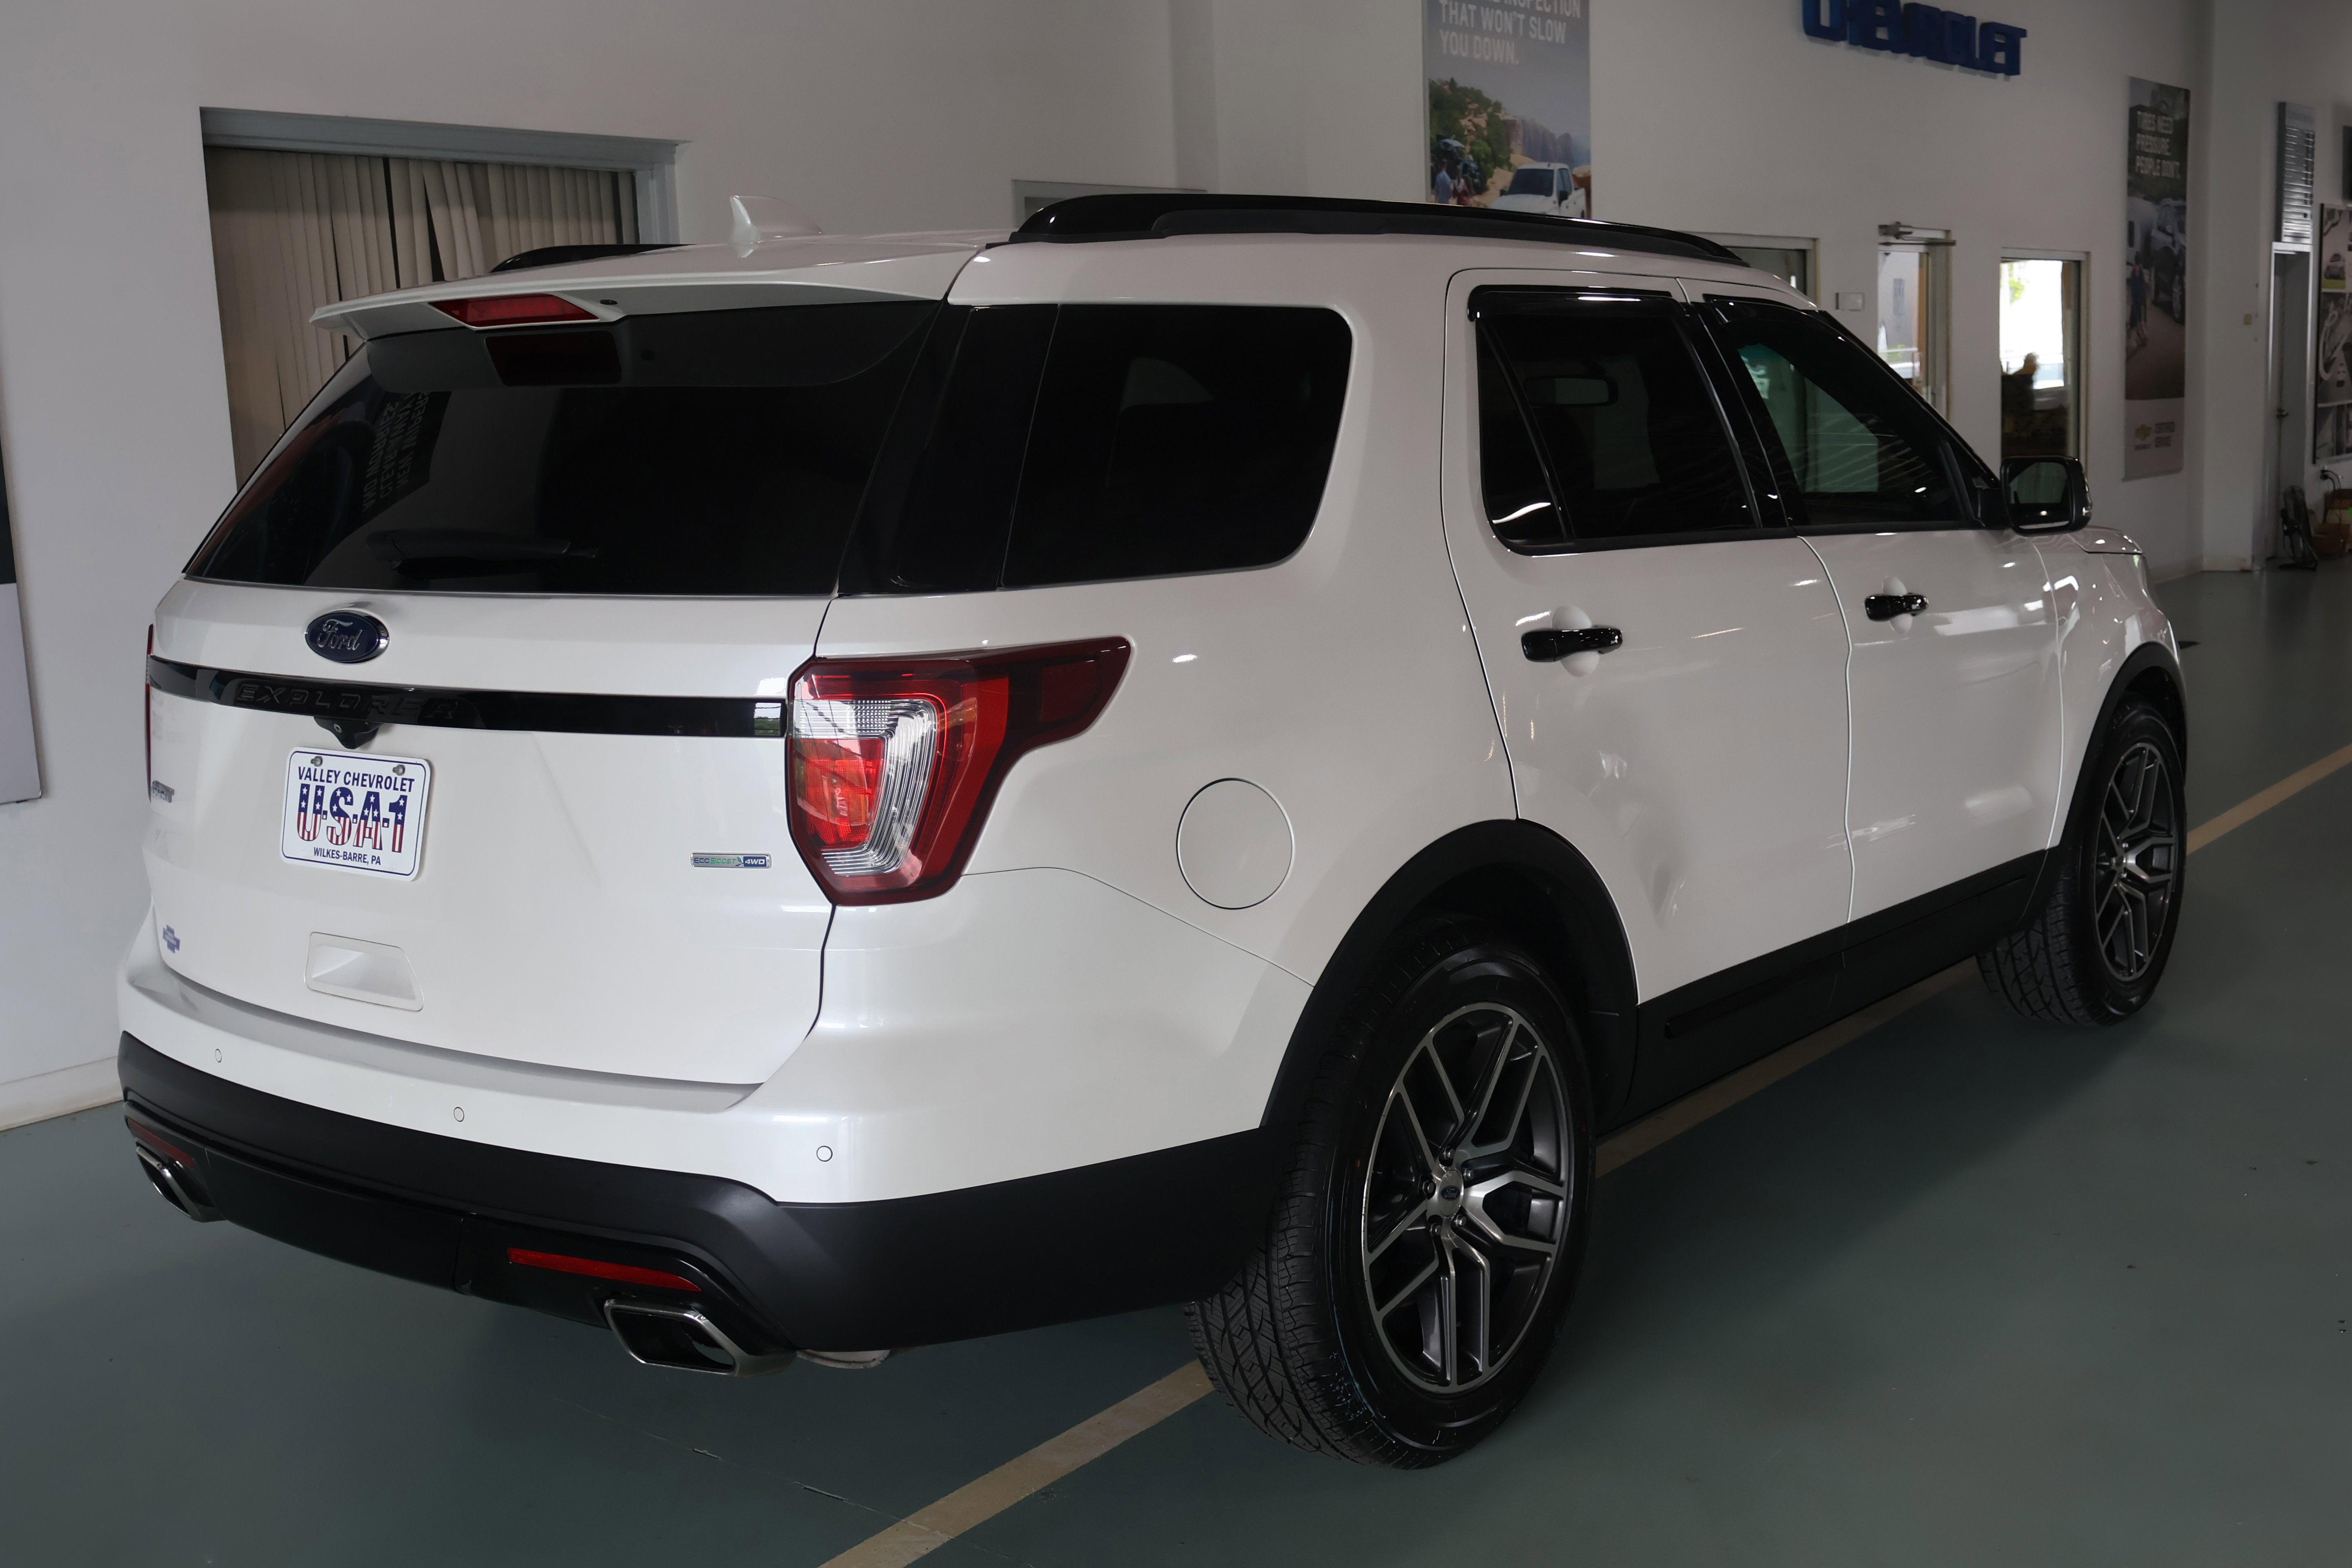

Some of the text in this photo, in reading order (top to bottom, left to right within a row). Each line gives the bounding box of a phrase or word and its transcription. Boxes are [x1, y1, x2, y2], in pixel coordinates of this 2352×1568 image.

[1439, 0, 1566, 44] THAT WON'T SLOW
[1504, 0, 1581, 18] ECTION
[1439, 29, 1519, 65] YOU DOWN.
[316, 618, 363, 652] Ford
[236, 684, 457, 720] EXPLORER
[298, 766, 414, 792] VALLEY CHEVROLET
[314, 847, 381, 866] WILKES-BARRE, PA
[1444, 1188, 1458, 1198] Ford
